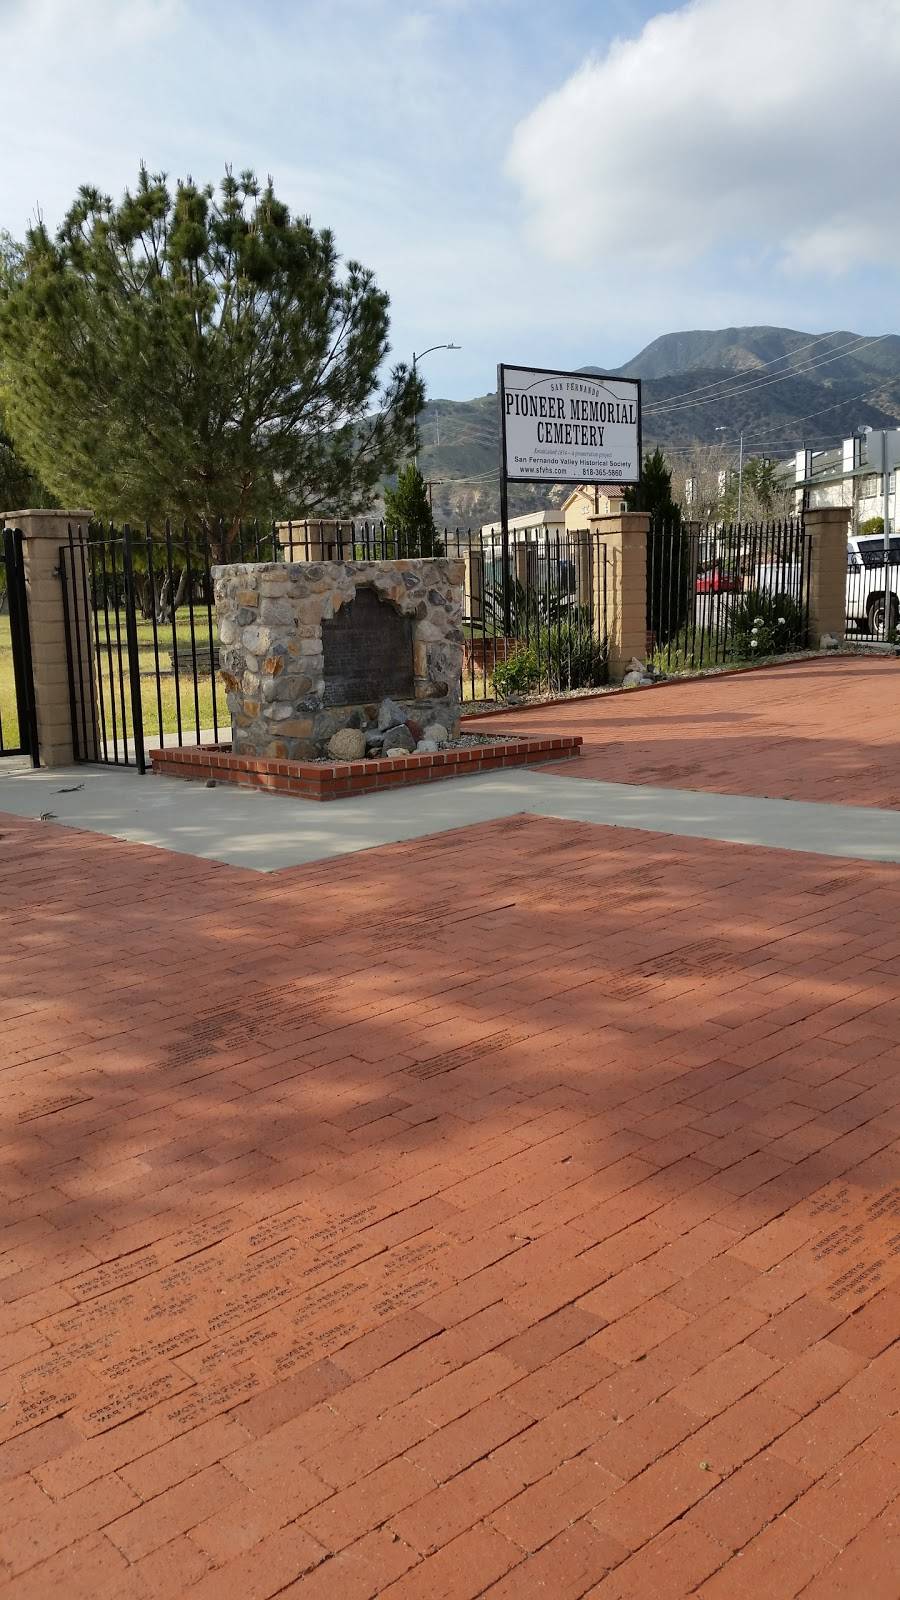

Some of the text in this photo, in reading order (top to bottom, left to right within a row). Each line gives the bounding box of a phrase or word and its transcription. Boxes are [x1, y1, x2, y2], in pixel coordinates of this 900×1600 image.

[550, 382, 600, 397] SAN FERNANDO
[505, 393, 637, 425] PIONEER MEMORIAL
[537, 421, 605, 447] CEMETERY
[529, 456, 559, 465] Fernando
[560, 458, 578, 467] Valley
[579, 459, 608, 467] Historical
[609, 460, 632, 468] Society
[519, 466, 623, 477] www.sfvhs.com 818-365-5860
